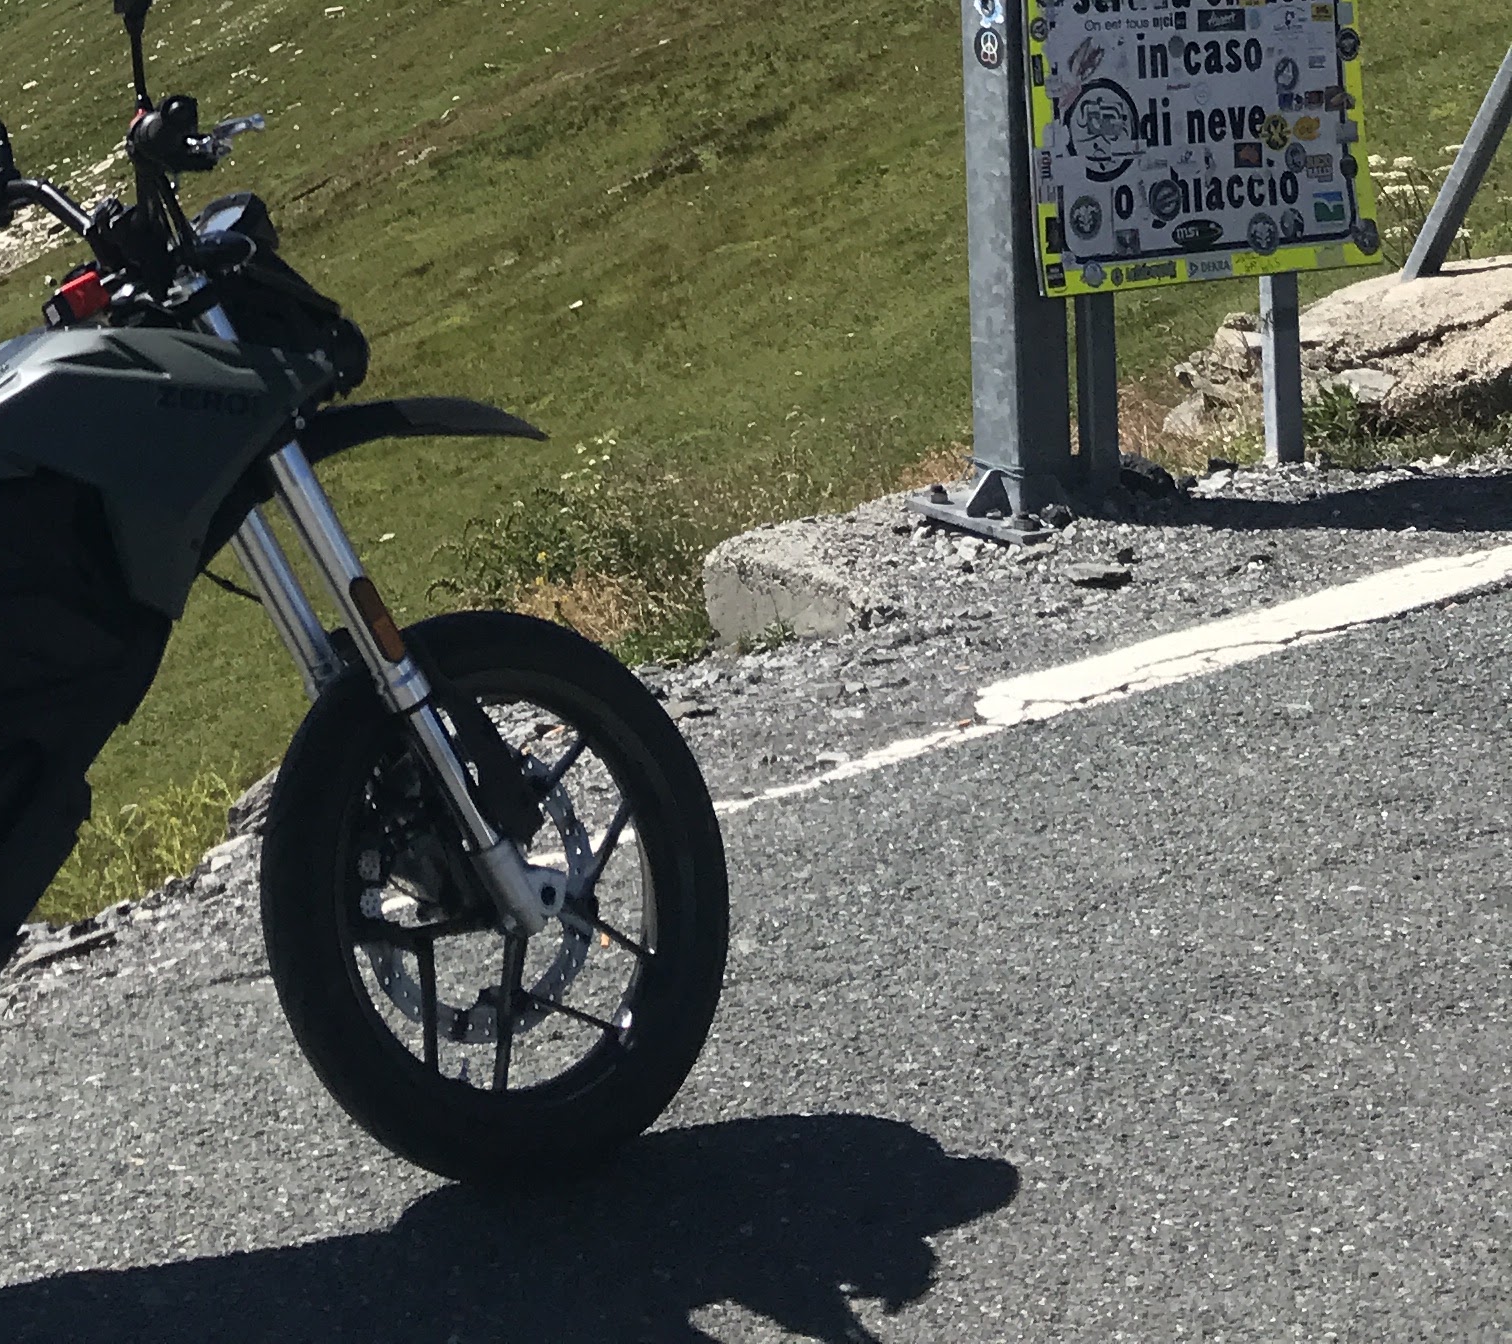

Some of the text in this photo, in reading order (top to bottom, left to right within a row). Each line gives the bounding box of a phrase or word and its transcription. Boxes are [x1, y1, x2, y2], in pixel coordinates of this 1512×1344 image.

[1085, 19, 1103, 32] On
[1126, 18, 1149, 30] tous
[1136, 33, 1263, 79] in caso
[1140, 97, 1266, 147] di neve
[1114, 184, 1134, 220] o
[1149, 160, 1299, 228] hiaccio
[1176, 226, 1200, 240] msi
